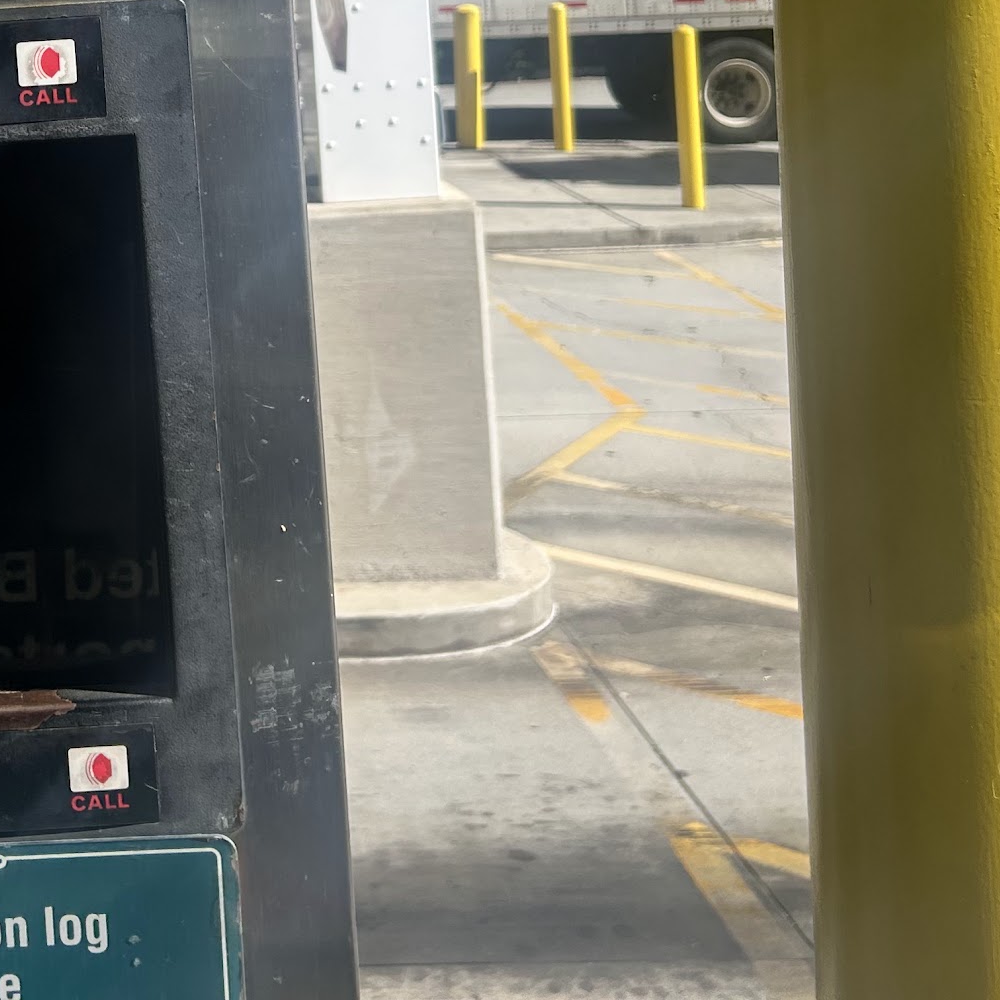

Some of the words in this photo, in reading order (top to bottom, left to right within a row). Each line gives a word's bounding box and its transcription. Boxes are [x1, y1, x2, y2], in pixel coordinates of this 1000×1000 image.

[19, 87, 78, 107] CALL
[70, 792, 130, 812] CALL
[45, 906, 109, 954] log
